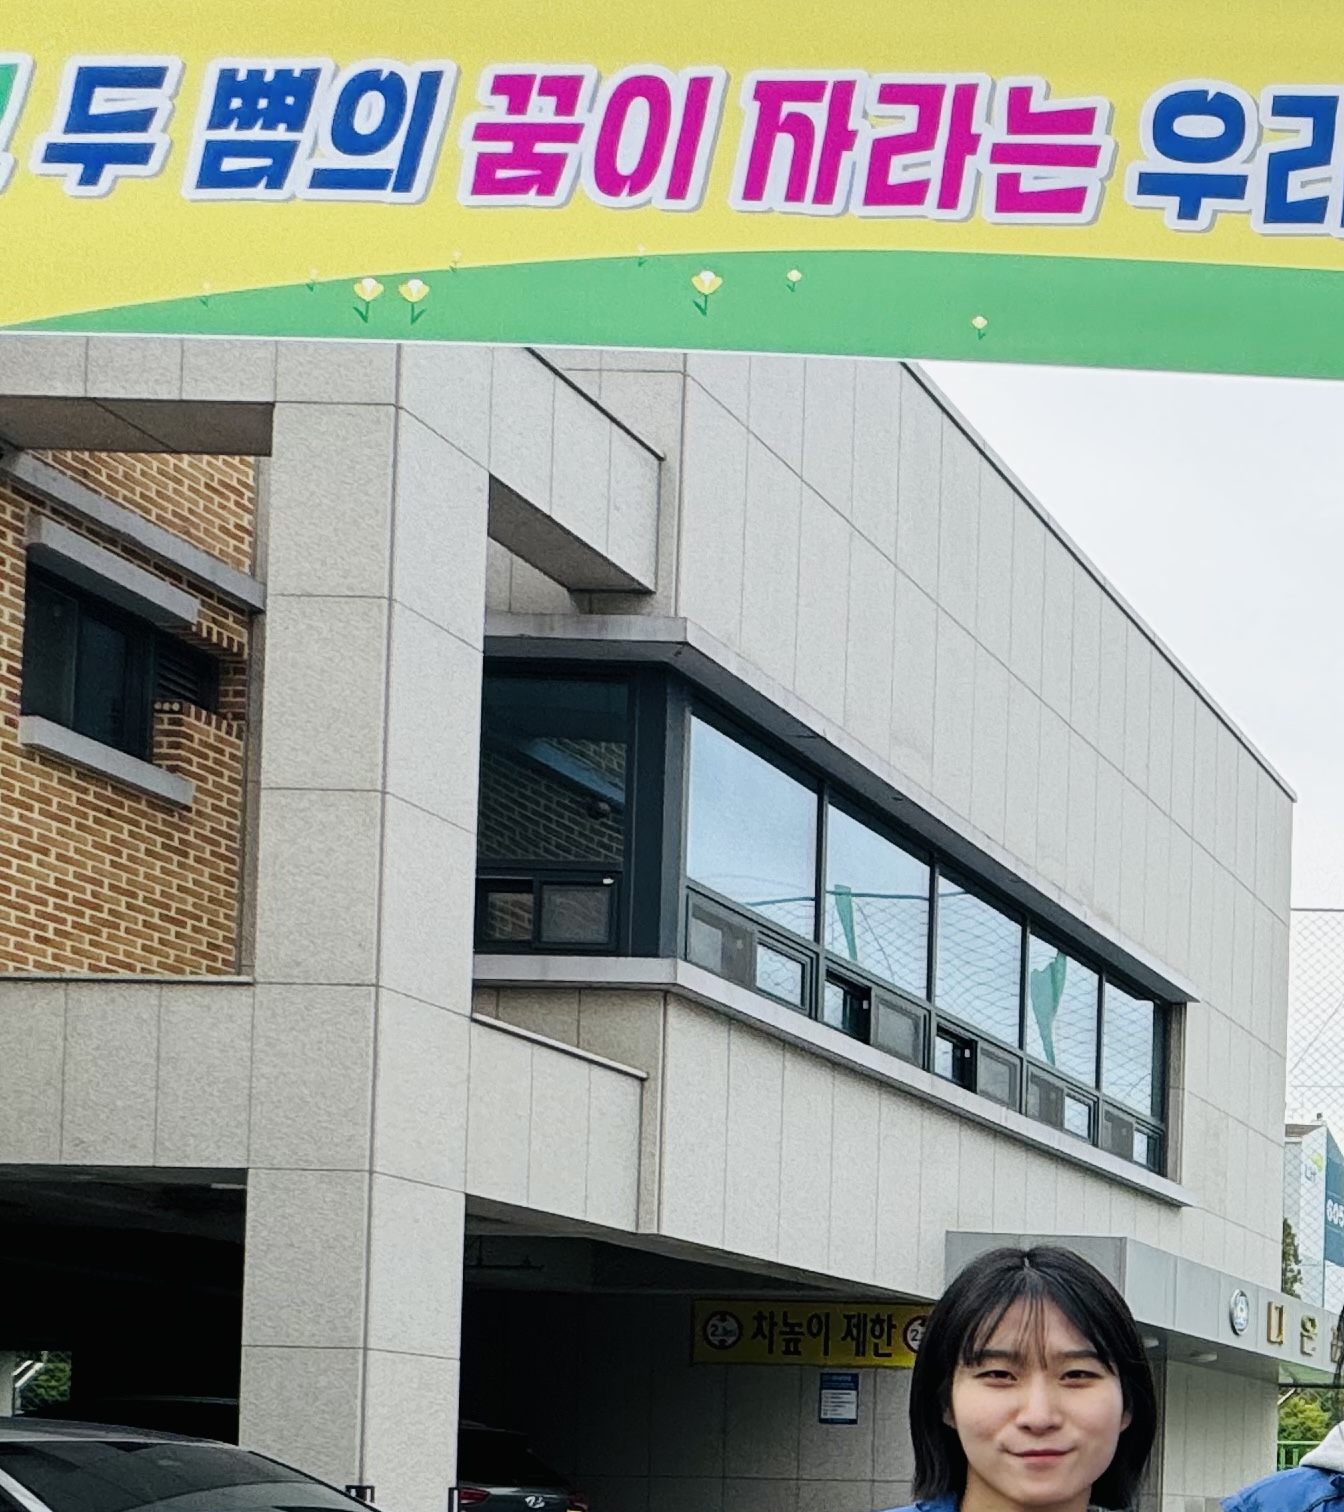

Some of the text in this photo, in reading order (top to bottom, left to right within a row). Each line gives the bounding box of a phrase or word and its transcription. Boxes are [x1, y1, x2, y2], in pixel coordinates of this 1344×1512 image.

[41, 65, 170, 187] 두
[471, 74, 713, 199] 꿈이
[742, 80, 1101, 214] 자라는
[751, 1310, 898, 1358] 차높이 제한
